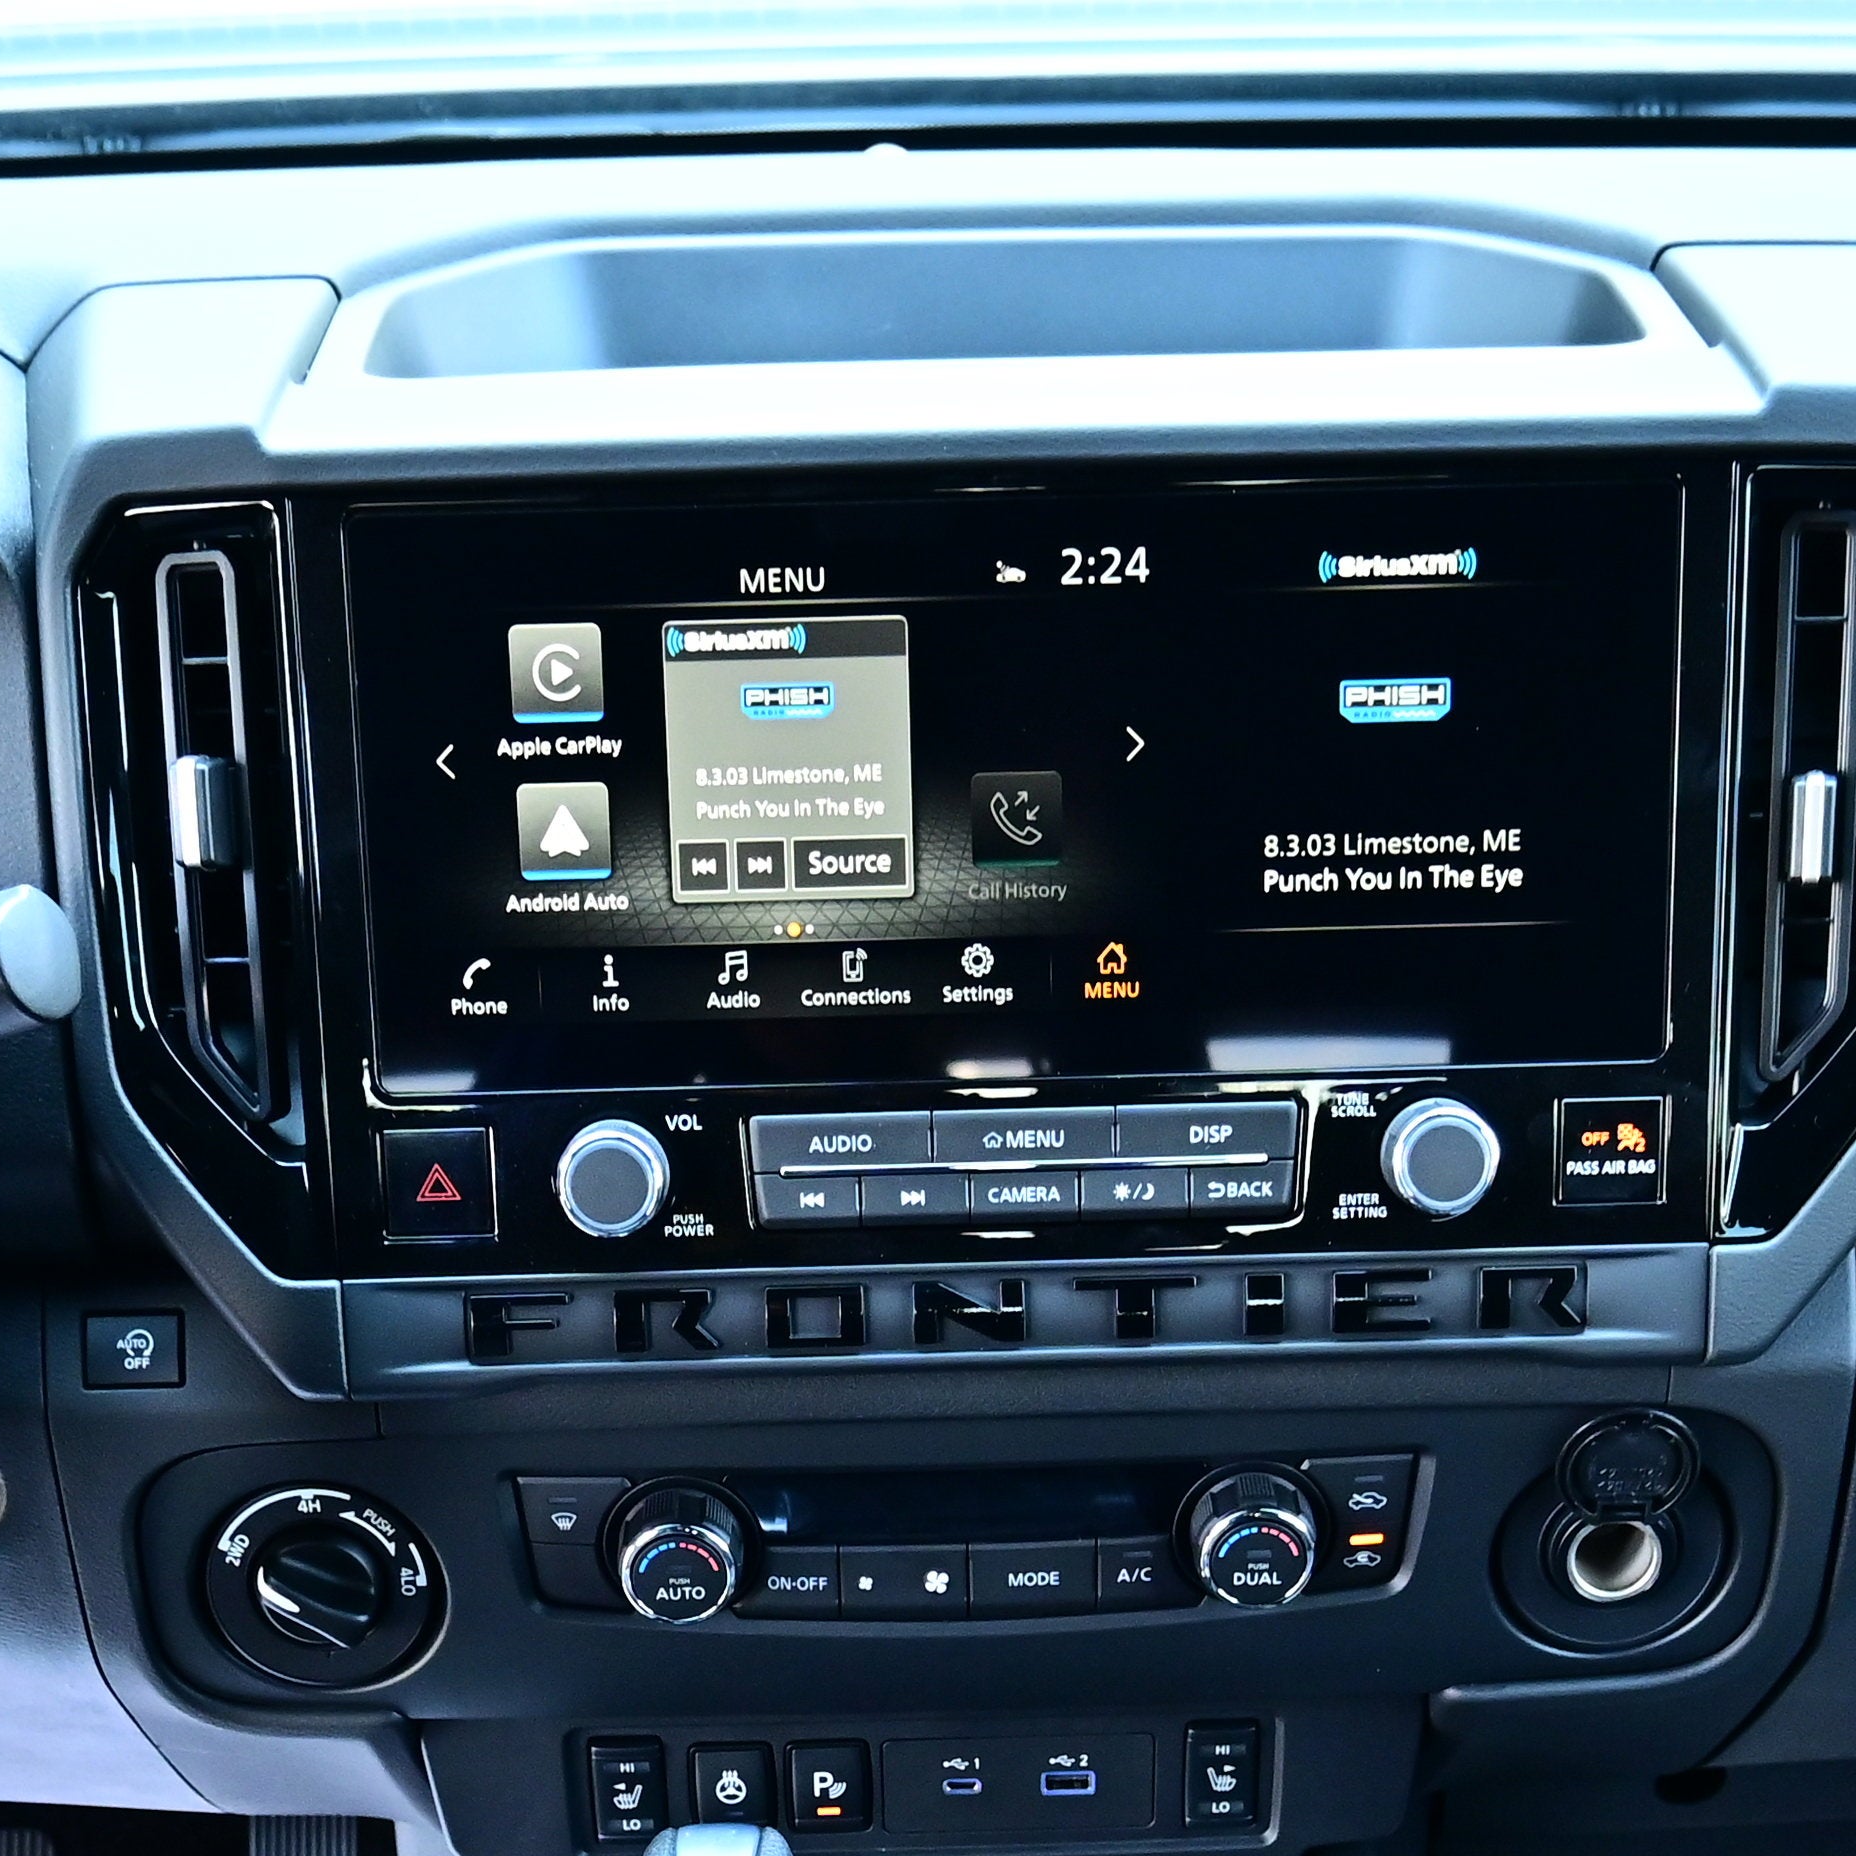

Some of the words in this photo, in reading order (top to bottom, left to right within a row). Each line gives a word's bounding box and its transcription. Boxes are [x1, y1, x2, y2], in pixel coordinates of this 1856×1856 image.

[1061, 547, 1150, 584] 2:24
[739, 567, 826, 594] MENU
[745, 687, 829, 706] PHISH
[1345, 684, 1445, 708] PHISH
[496, 736, 552, 758] Apple
[554, 735, 623, 758] CarPlay
[695, 766, 749, 786] 8.3.03
[752, 765, 850, 786] Limestone,
[853, 764, 883, 783] ME
[696, 801, 751, 821] Punch
[754, 800, 791, 820] You
[794, 799, 812, 819] In
[815, 799, 851, 819] The
[854, 798, 886, 820] Eye
[1263, 833, 1337, 860] 8.3.03
[1343, 830, 1476, 858] Limestone,
[1482, 828, 1521, 853] ME
[807, 850, 893, 875] Source
[1263, 867, 1339, 894] Punch
[1345, 867, 1396, 892] You
[1399, 866, 1424, 891] In
[1429, 865, 1475, 890] The
[1480, 865, 1524, 892] Eye
[968, 881, 1001, 900] Call
[1003, 880, 1068, 902] History
[505, 892, 581, 914] Android
[584, 892, 630, 912] Auto
[801, 986, 912, 1007] Connections
[942, 983, 1014, 1006] Settings
[1084, 980, 1140, 1000] MENU
[450, 998, 509, 1017] Phone
[592, 994, 630, 1013] Info
[707, 990, 761, 1010] Audio
[1336, 1092, 1370, 1106] TUNE
[1330, 1105, 1377, 1118] SCROLL
[664, 1114, 703, 1132] VOL
[1005, 1129, 1065, 1149] MENU
[1189, 1124, 1233, 1144] DISP
[1581, 1131, 1610, 1147] OFF
[808, 1135, 872, 1153] AUDIO
[1566, 1160, 1600, 1175] PASS
[1601, 1160, 1626, 1175] AIR
[1627, 1159, 1656, 1174] BAG
[987, 1186, 1060, 1204] CAMERA
[1227, 1180, 1273, 1198] BACK
[1338, 1193, 1380, 1206] ENTER
[672, 1213, 704, 1225] PUSH
[1332, 1206, 1388, 1220] SETTING
[663, 1223, 714, 1238] POWER
[466, 1265, 1587, 1357] FRONTIER
[116, 1338, 147, 1350] AUTO
[123, 1356, 151, 1370] OFF
[297, 1499, 321, 1514] 4H
[362, 1508, 397, 1538] PUSH
[225, 1534, 250, 1566] 2WD
[1116, 1566, 1153, 1584] A/C
[1247, 1562, 1270, 1571] PUSH
[668, 1576, 692, 1585] PUSH
[1007, 1570, 1061, 1587] MODE
[1232, 1571, 1283, 1588] DUAL
[655, 1586, 706, 1601] AUTO
[1214, 1745, 1231, 1756] HI
[618, 1762, 635, 1773] HI
[973, 1758, 981, 1771] 1
[1078, 1754, 1089, 1767] 2
[1211, 1802, 1230, 1813] LO
[622, 1819, 641, 1831] LO
